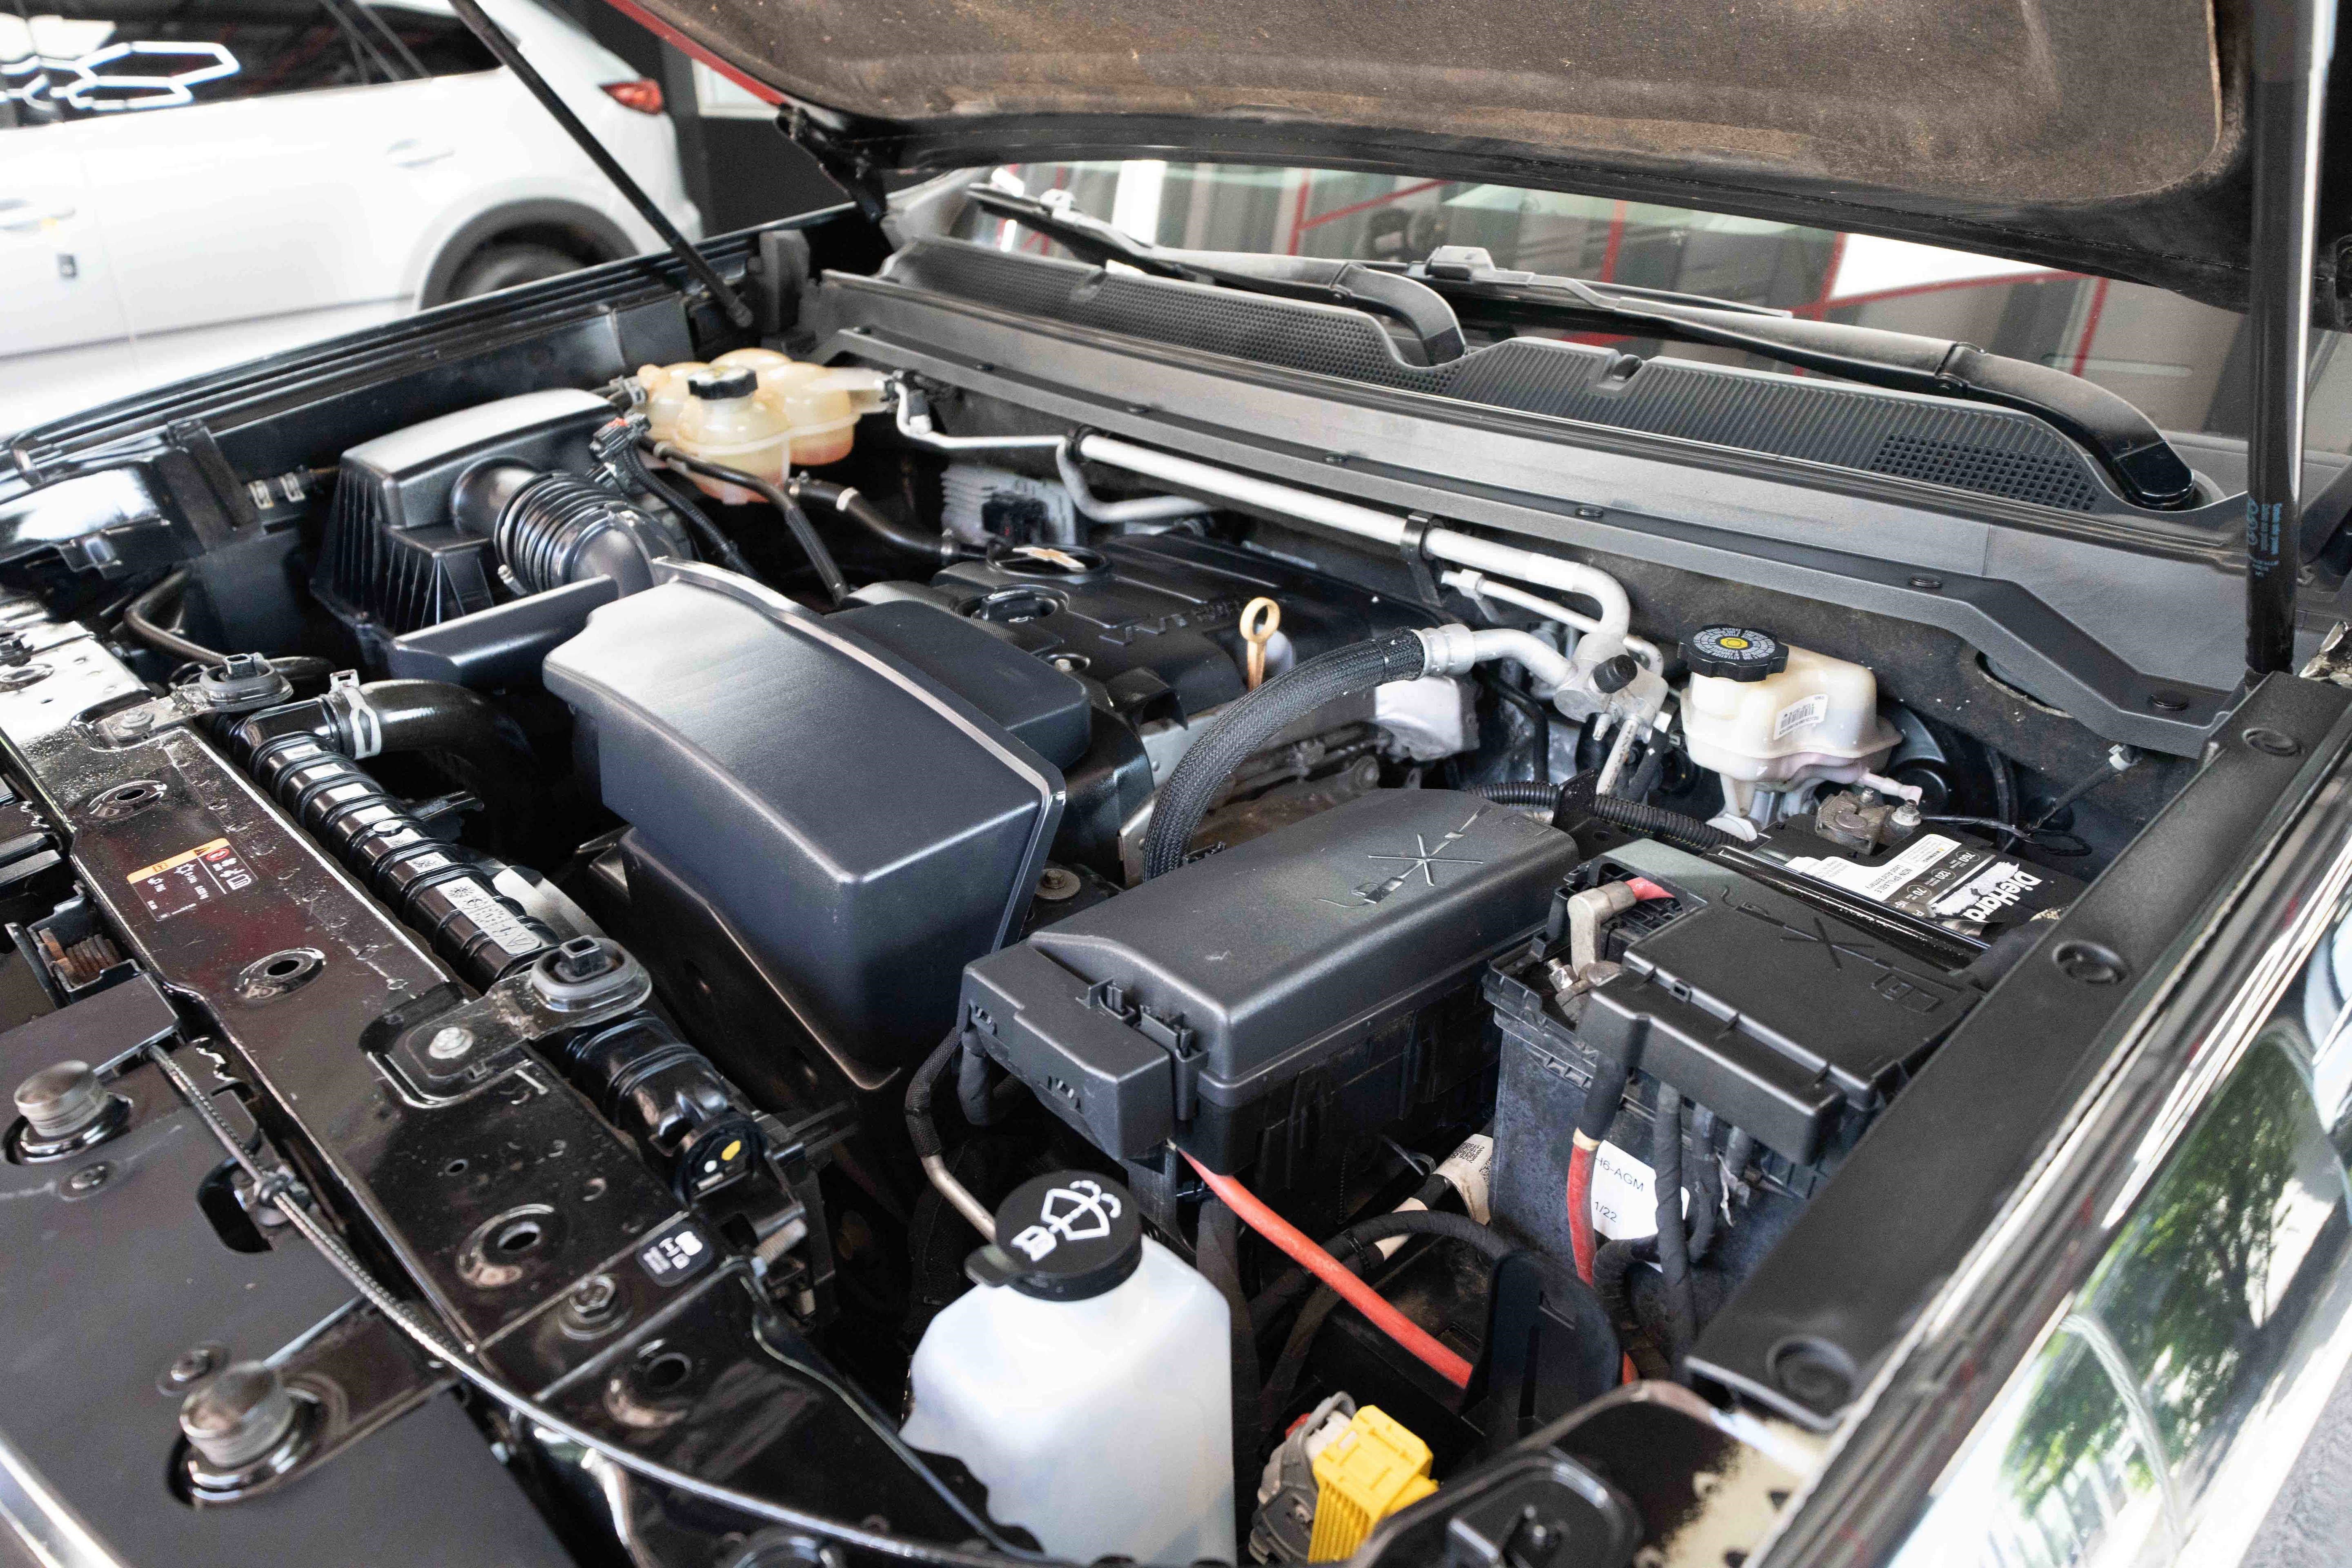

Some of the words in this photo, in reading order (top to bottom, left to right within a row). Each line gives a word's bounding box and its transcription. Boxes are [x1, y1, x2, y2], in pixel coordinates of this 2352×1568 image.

[1958, 852, 1976, 862] 760
[1890, 864, 1904, 873] Lead
[1935, 870, 1951, 880] 120
[1865, 878, 1884, 889] Battery
[1874, 868, 1913, 893] NON-SPILLABLE
[1912, 887, 1928, 896] 70
[1962, 871, 2042, 923] DieHard
